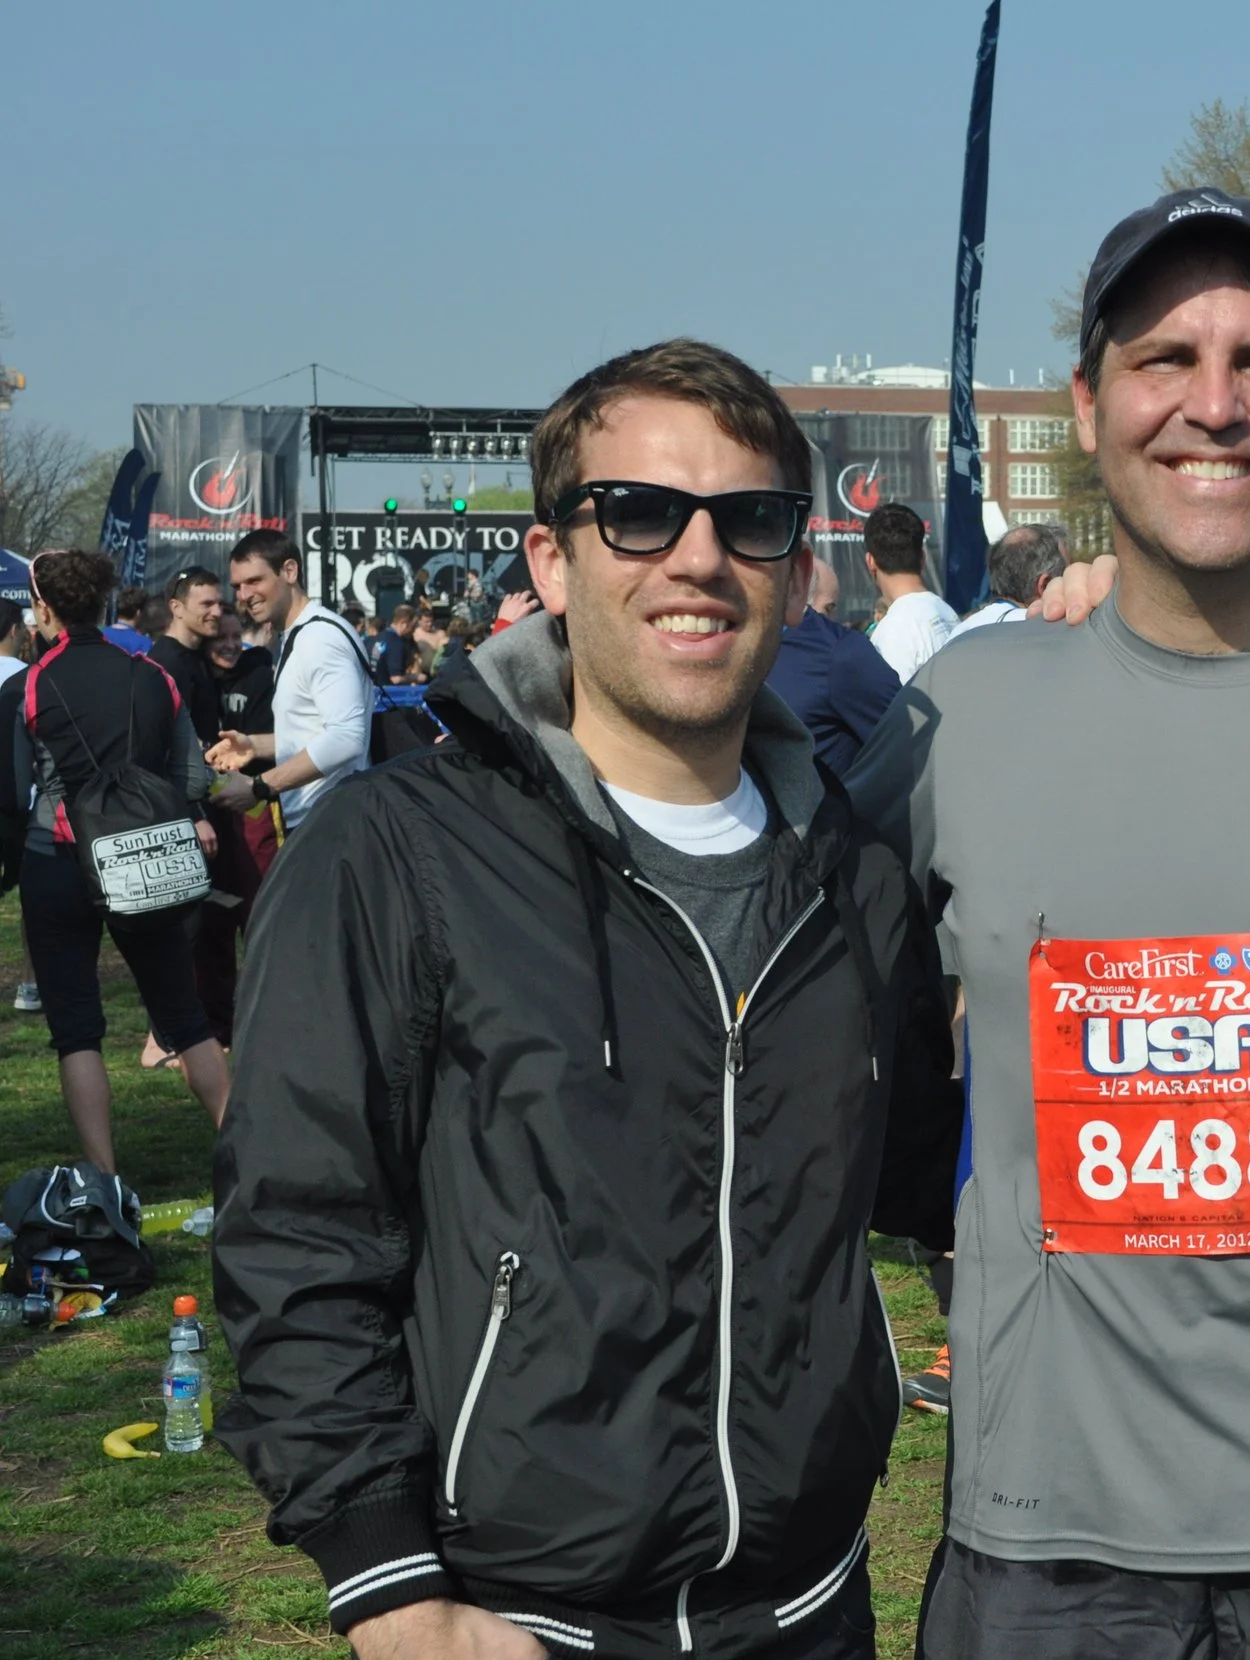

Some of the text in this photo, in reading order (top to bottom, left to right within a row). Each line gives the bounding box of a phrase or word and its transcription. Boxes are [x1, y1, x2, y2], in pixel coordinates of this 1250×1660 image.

[1168, 204, 1243, 222] adidas
[160, 531, 235, 542] MARATHON
[375, 526, 470, 550] READY
[476, 526, 520, 550] TO
[815, 533, 865, 543] MARATH
[113, 826, 182, 852] SunTrust
[101, 850, 151, 869] Rock
[163, 840, 198, 855] Roll
[144, 852, 203, 880] USA
[1085, 947, 1204, 979] CareFirst
[1050, 982, 1168, 1014] Rock
[1168, 992, 1205, 1012] 'n'
[1089, 985, 1136, 994] INAUGURAL
[1098, 1079, 1130, 1099] 1/2
[1124, 1233, 1180, 1249] MARCH
[1186, 1234, 1211, 1250] 17,
[991, 1491, 1041, 1509] DRI-FIT
